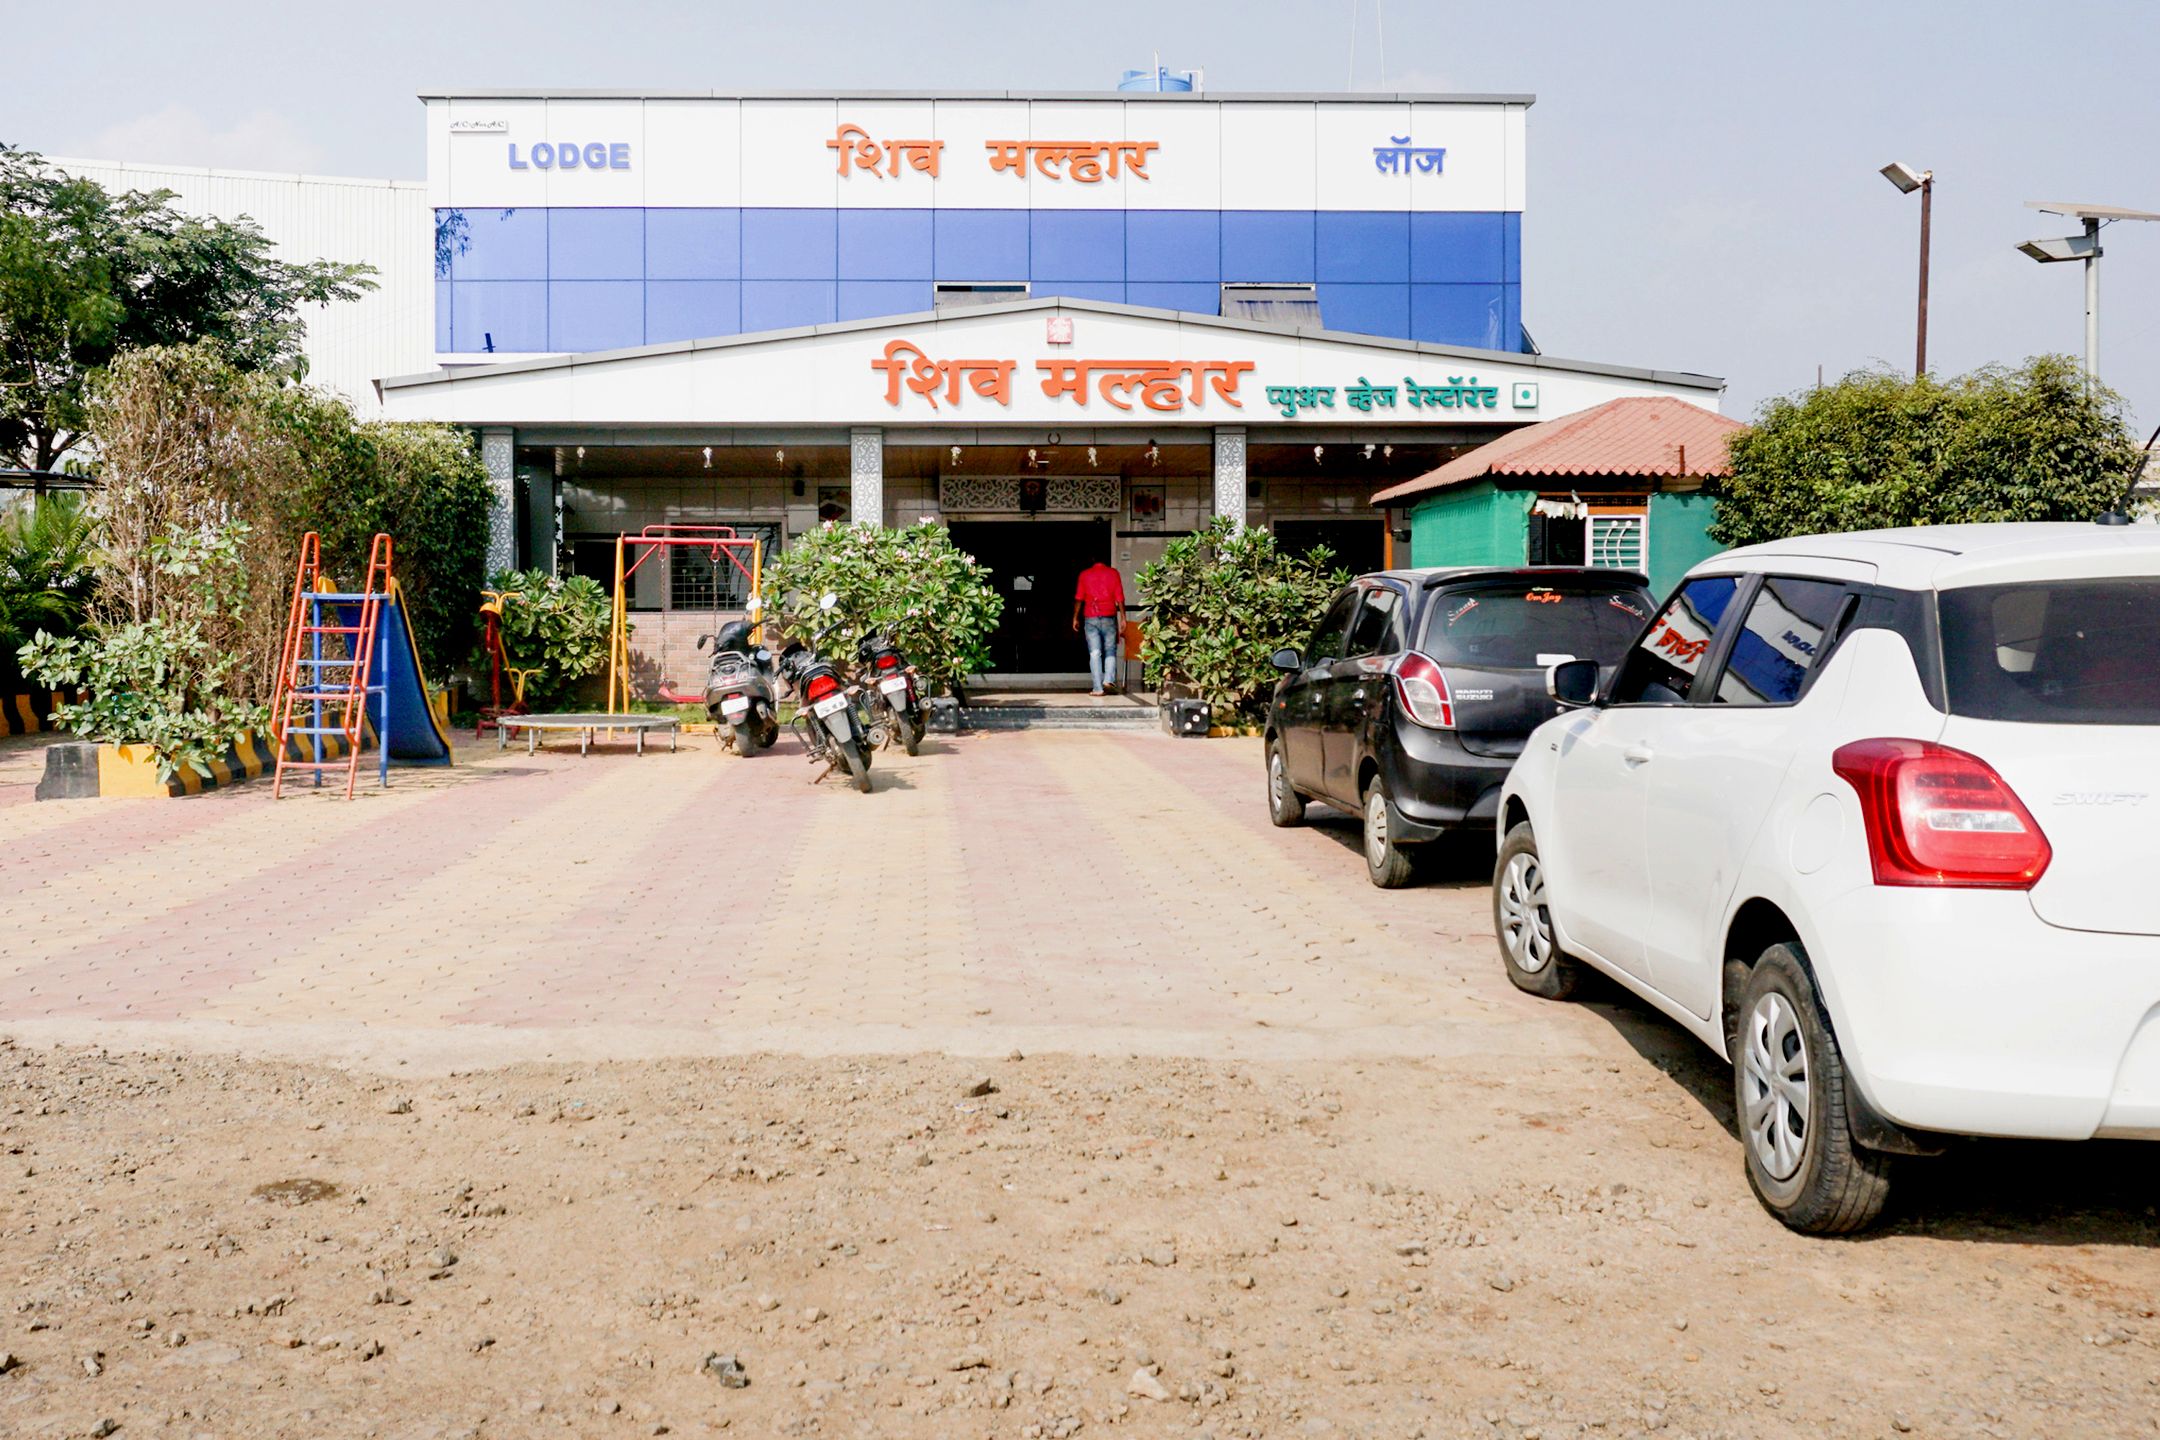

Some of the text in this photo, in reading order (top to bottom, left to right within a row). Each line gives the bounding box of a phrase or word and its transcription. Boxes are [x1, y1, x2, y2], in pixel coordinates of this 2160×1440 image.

[509, 143, 630, 169] LODGE
[826, 124, 1160, 183] शिव मल्हार
[1374, 136, 1446, 174] लॉज
[871, 340, 1256, 412] शिव मल्हार
[1266, 376, 1499, 417] प्युअर व्हेज रेस्टॉरंट
[2053, 792, 2149, 806] SWIFT
